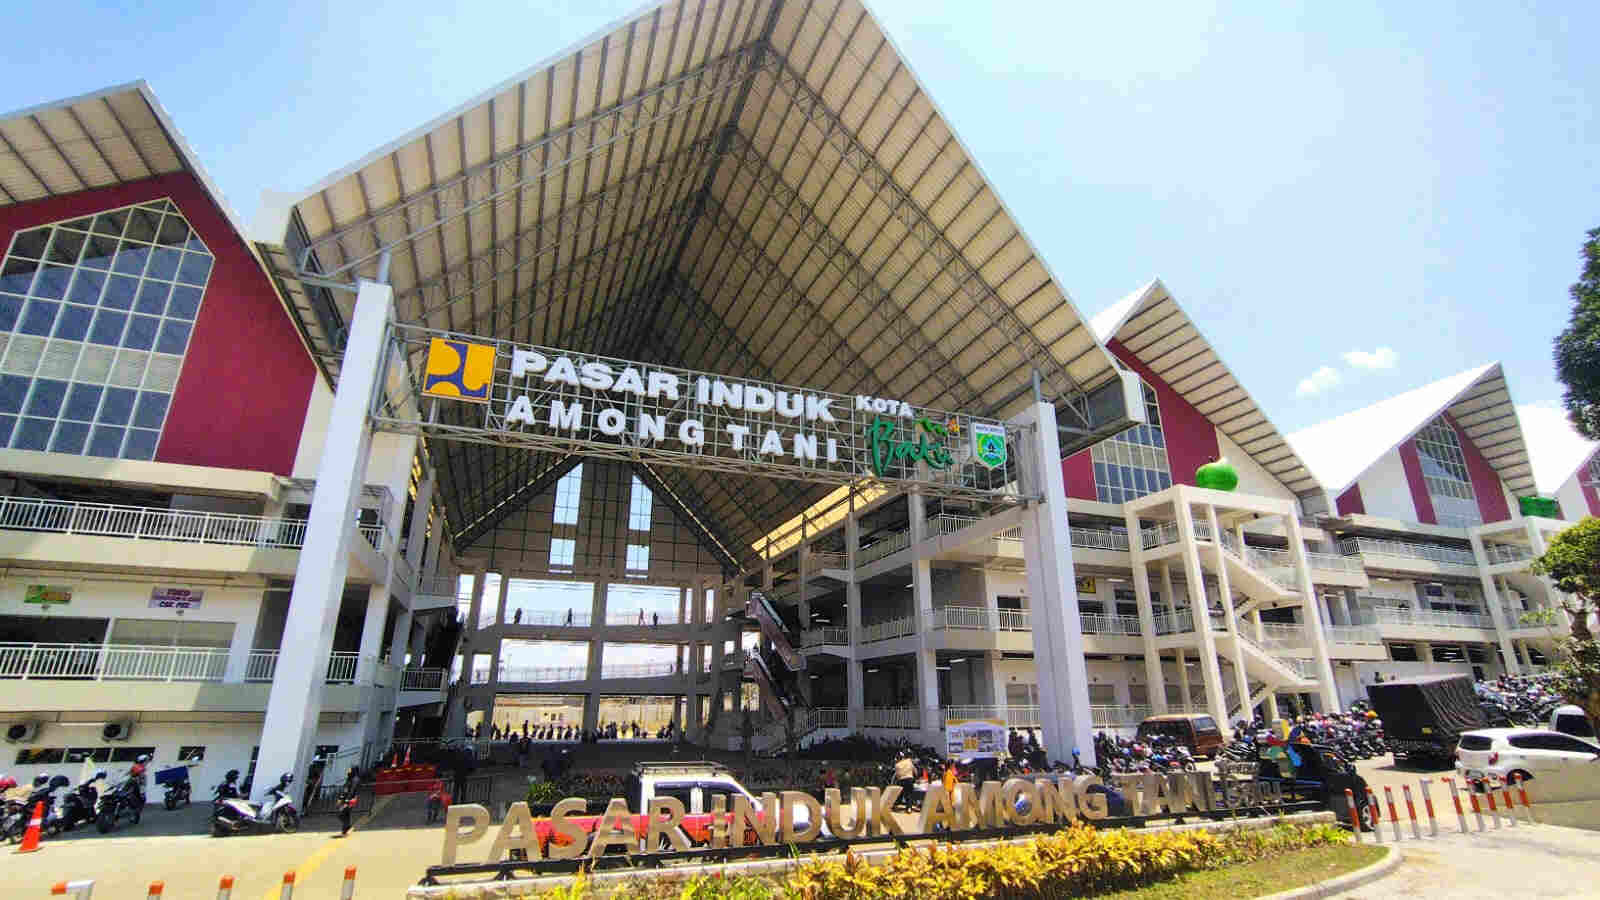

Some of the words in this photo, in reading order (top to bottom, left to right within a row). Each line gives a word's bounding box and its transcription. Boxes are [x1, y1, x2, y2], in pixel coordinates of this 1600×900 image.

[511, 349, 680, 400] PASAR
[696, 375, 835, 423] INDUK
[856, 395, 914, 416] KOTA
[506, 395, 705, 448] AMONG
[726, 424, 837, 462] TANI
[871, 414, 957, 477] Batu
[442, 796, 692, 865] PASAR
[711, 786, 904, 849] INDUK
[919, 774, 1109, 834] AMONG
[1112, 771, 1215, 817] TANI
